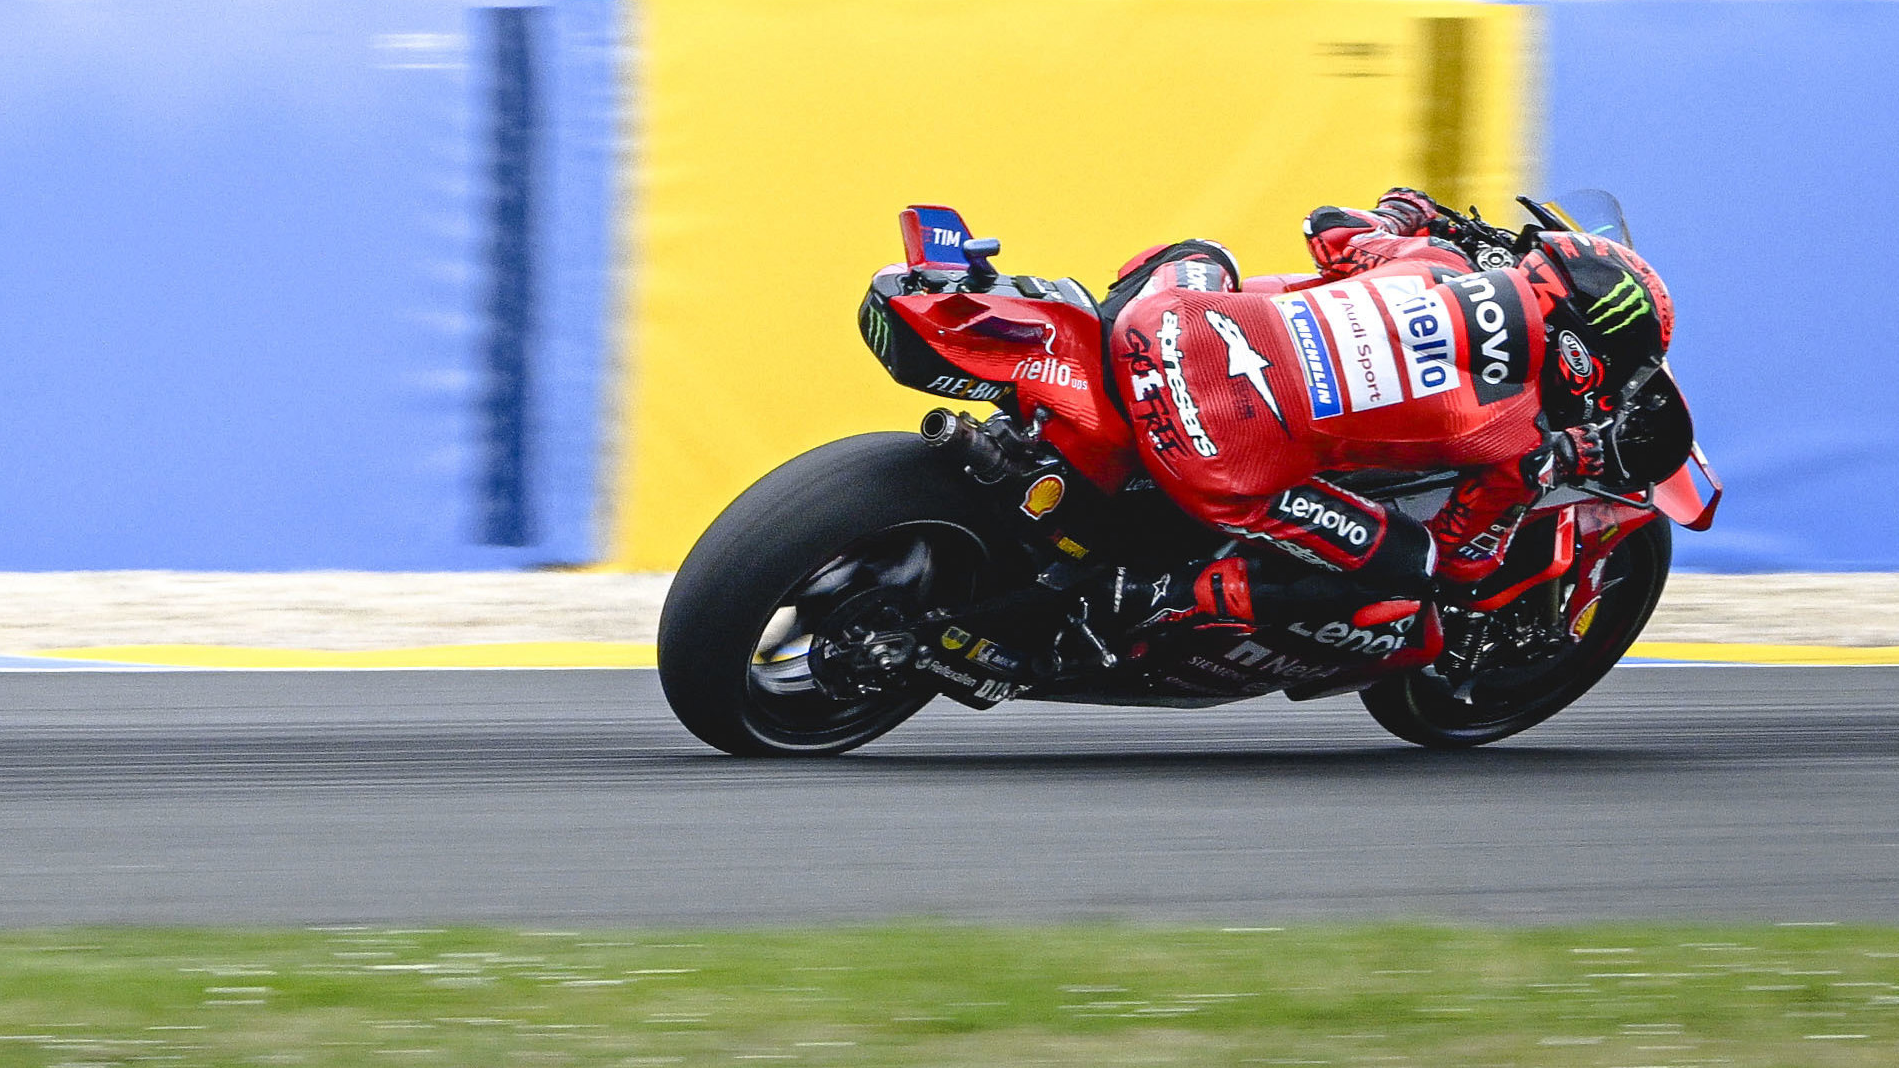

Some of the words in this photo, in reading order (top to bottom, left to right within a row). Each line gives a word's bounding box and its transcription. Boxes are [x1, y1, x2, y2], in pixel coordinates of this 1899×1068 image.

[933, 228, 961, 248] TIM
[1341, 302, 1367, 339] Audi
[1357, 343, 1382, 403] Sport
[1442, 273, 1511, 385] novo
[1563, 334, 1586, 374] SUOMY
[1011, 357, 1071, 387] riello
[1071, 379, 1088, 390] ups
[1156, 310, 1219, 458] alpinestars
[1295, 318, 1332, 405] MICHELIN
[1125, 478, 1155, 491] Len
[1278, 489, 1369, 546] Lenovo
